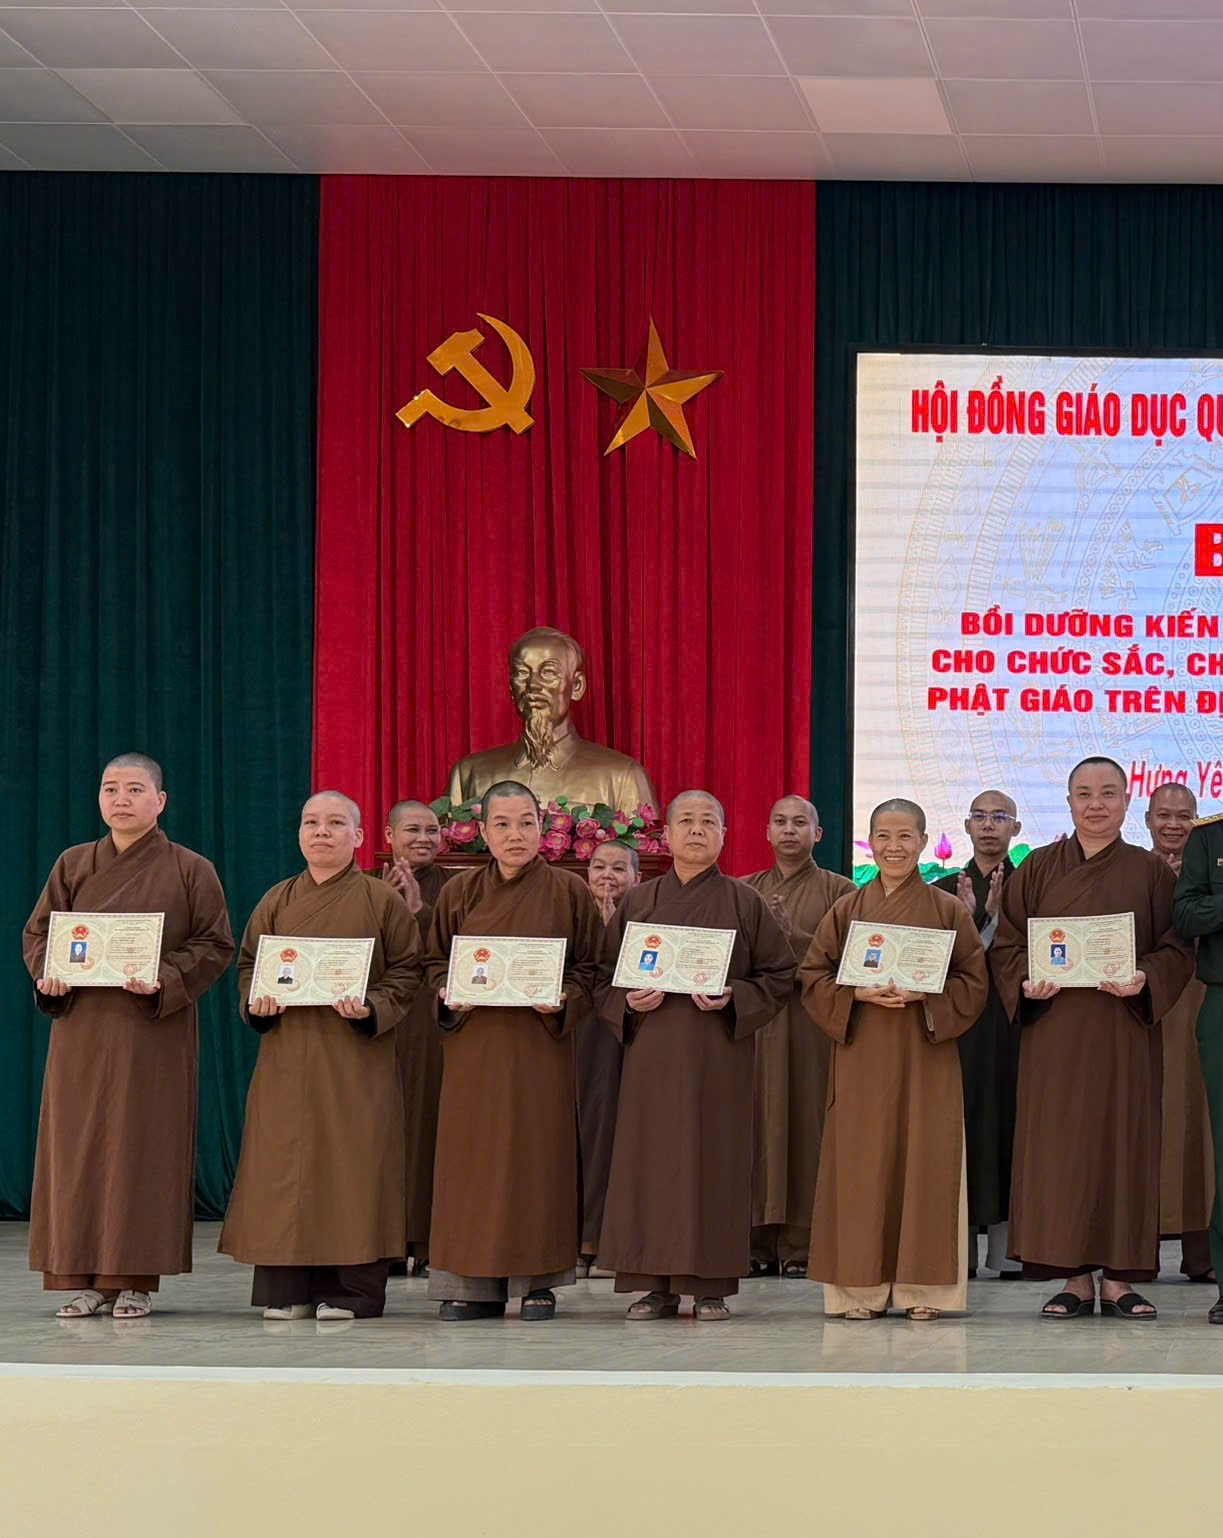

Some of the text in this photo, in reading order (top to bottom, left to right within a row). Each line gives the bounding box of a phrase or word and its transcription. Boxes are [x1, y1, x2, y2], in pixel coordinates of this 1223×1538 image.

[911, 380, 959, 444] HỘI
[966, 376, 1047, 436] ĐỒNG
[1055, 383, 1122, 438] GIÁO
[1130, 392, 1188, 447] DỤC
[960, 604, 1014, 637] BỒI
[1024, 607, 1134, 639] DƯỠNG
[1145, 607, 1219, 639] KIẾN
[931, 649, 996, 675] CHO
[1007, 647, 1092, 676] CHỨC
[1102, 644, 1175, 679] SẮC,
[927, 683, 1009, 716] PHẬT
[1019, 684, 1094, 713] GIÁO
[1104, 685, 1187, 714] TRÊN
